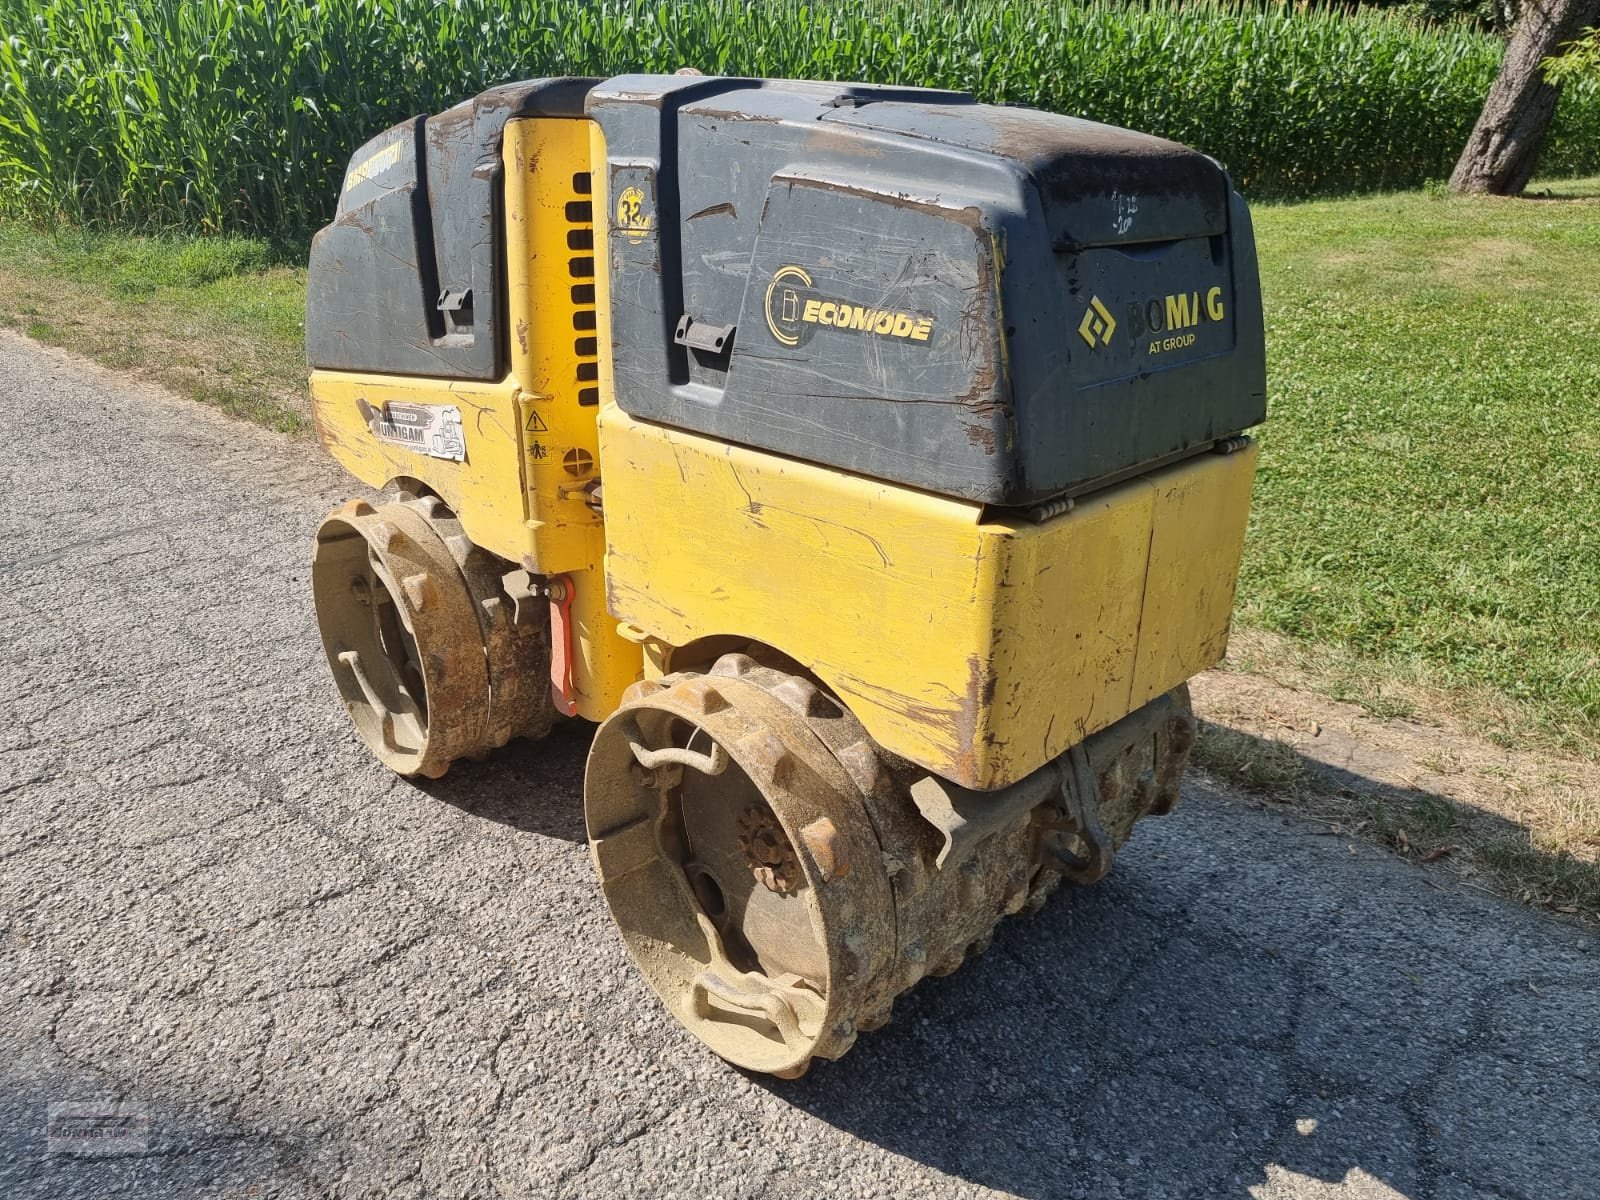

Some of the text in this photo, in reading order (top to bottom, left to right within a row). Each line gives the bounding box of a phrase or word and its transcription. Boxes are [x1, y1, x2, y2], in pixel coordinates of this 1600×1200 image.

[802, 299, 934, 341] ECOMODE
[1148, 333, 1196, 354] AT GROUP
[380, 423, 425, 442] UNTIGAM
